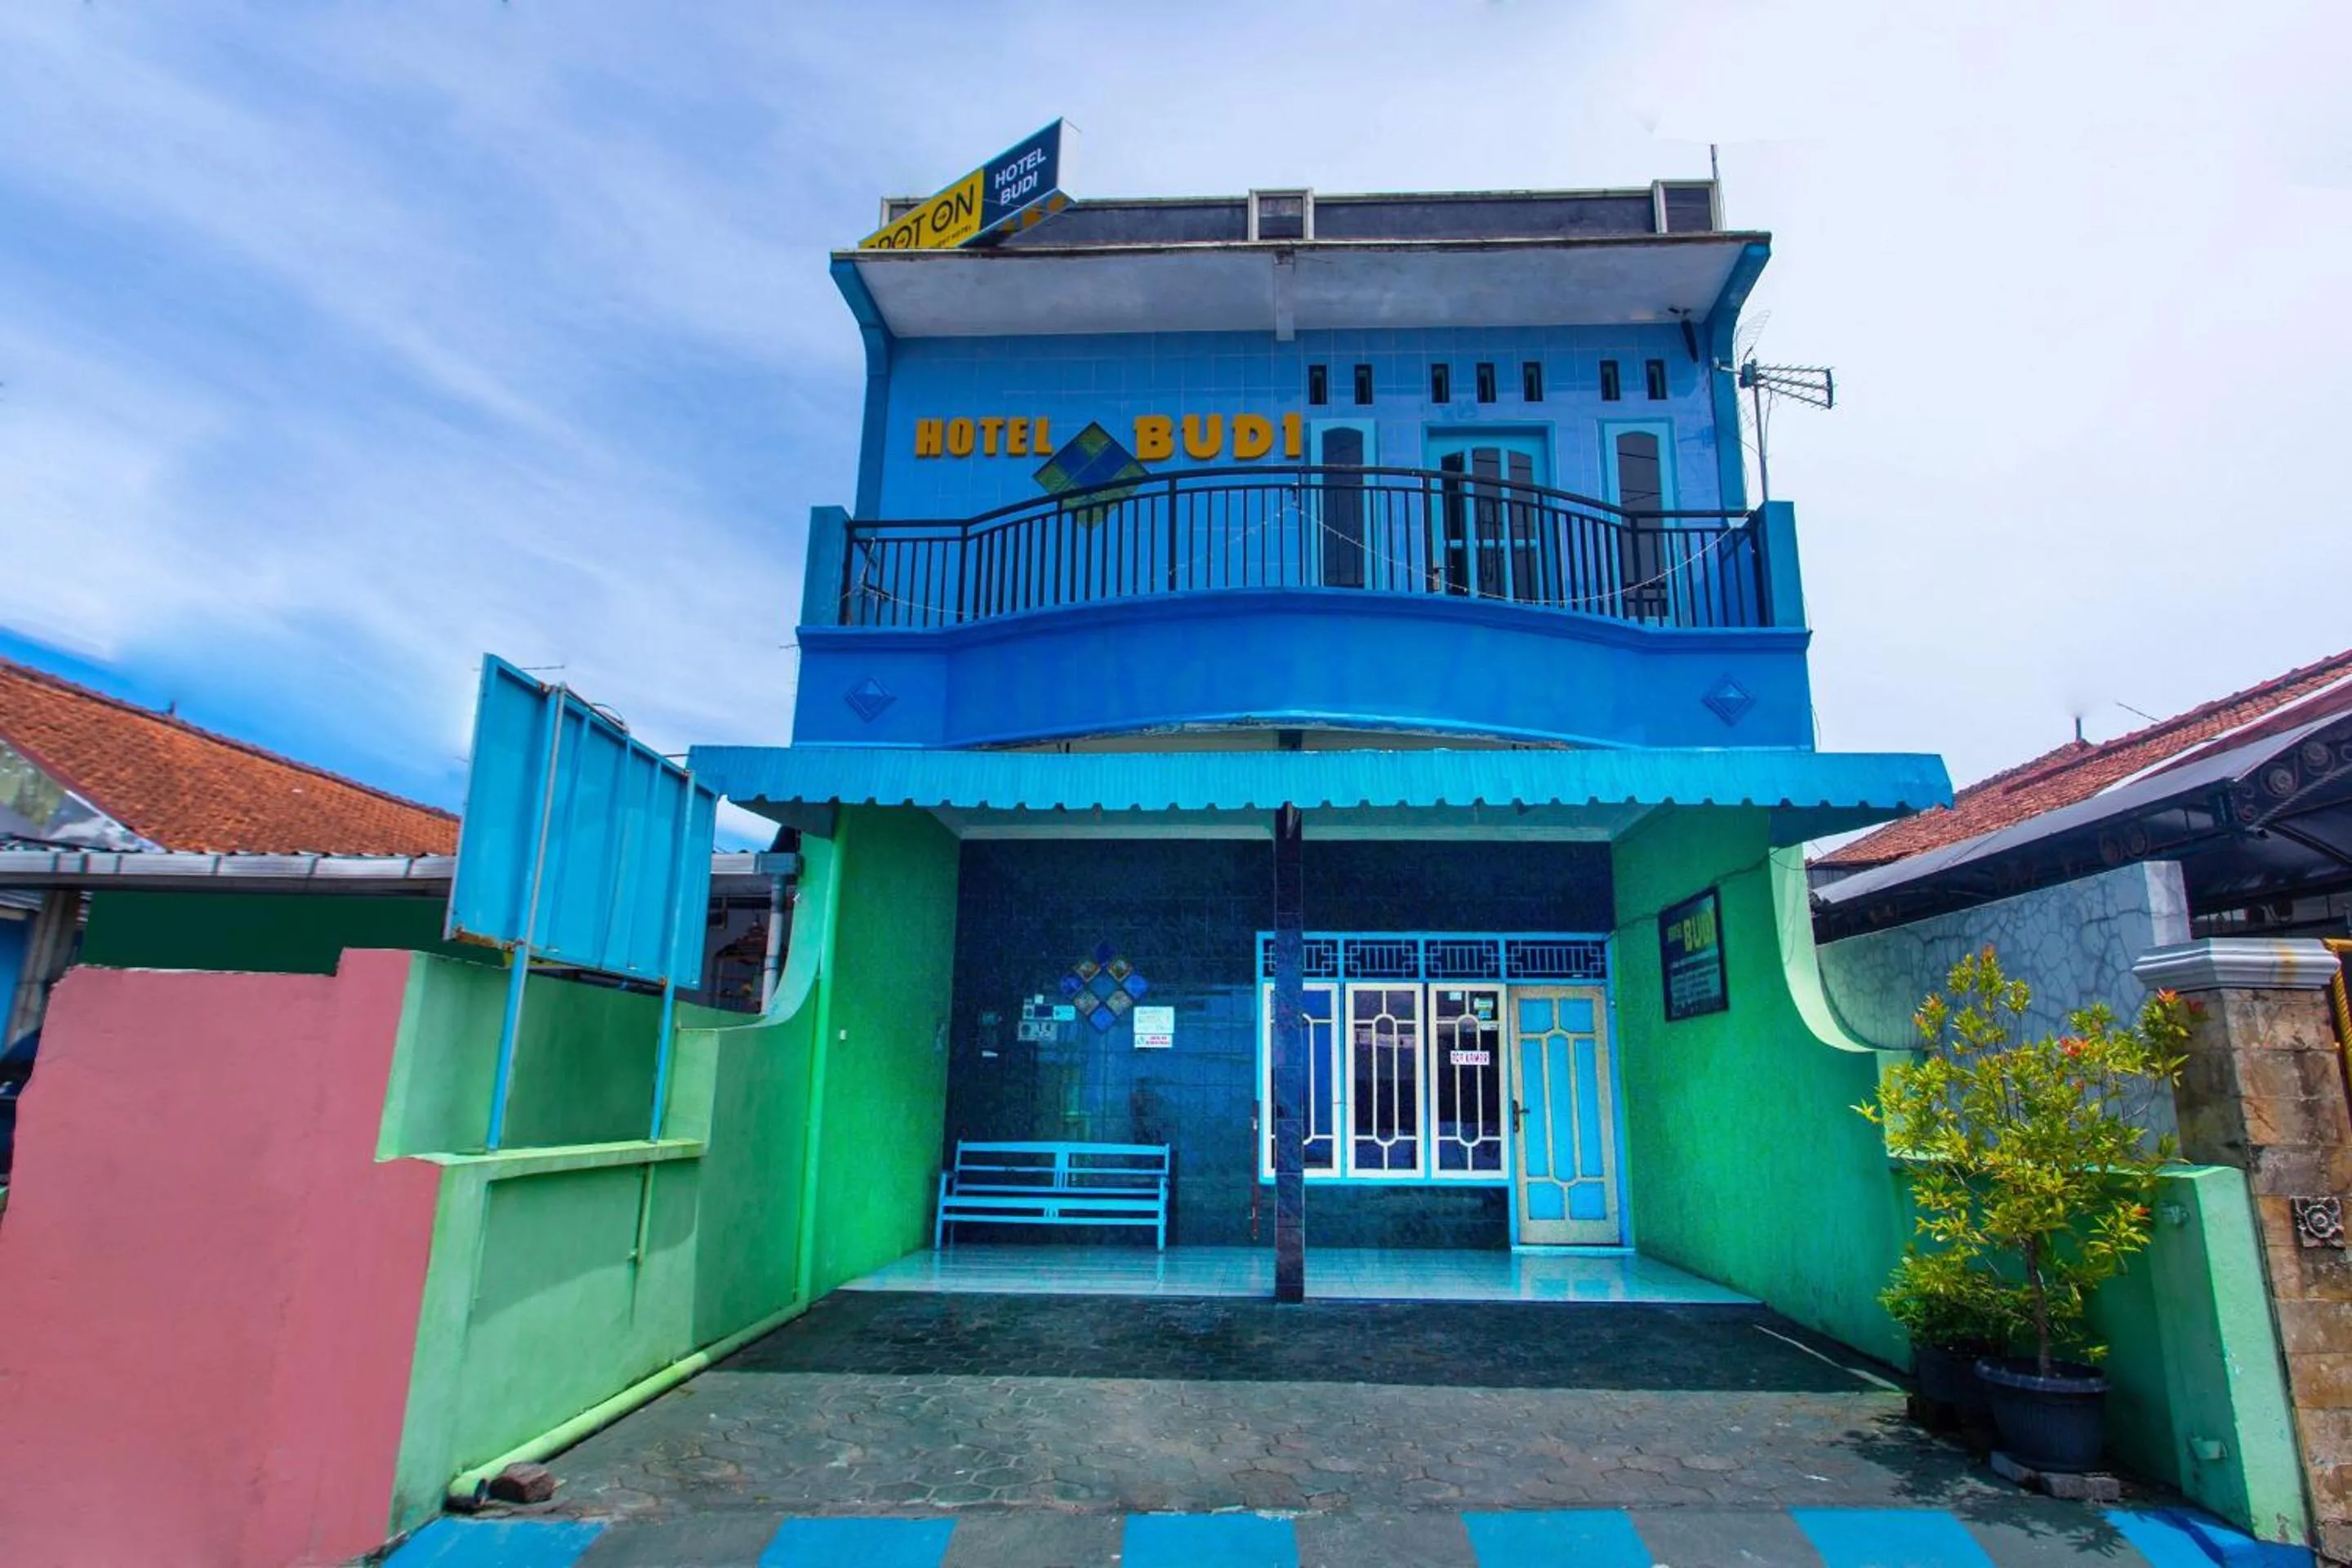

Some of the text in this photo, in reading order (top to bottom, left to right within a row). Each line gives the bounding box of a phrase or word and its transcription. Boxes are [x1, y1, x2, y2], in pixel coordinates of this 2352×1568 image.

[995, 148, 1047, 189] HOTEL
[1000, 172, 1039, 205] BUDI
[868, 213, 927, 248] POT
[930, 183, 975, 234] ON
[914, 413, 1303, 461] HOTEL BUDI
